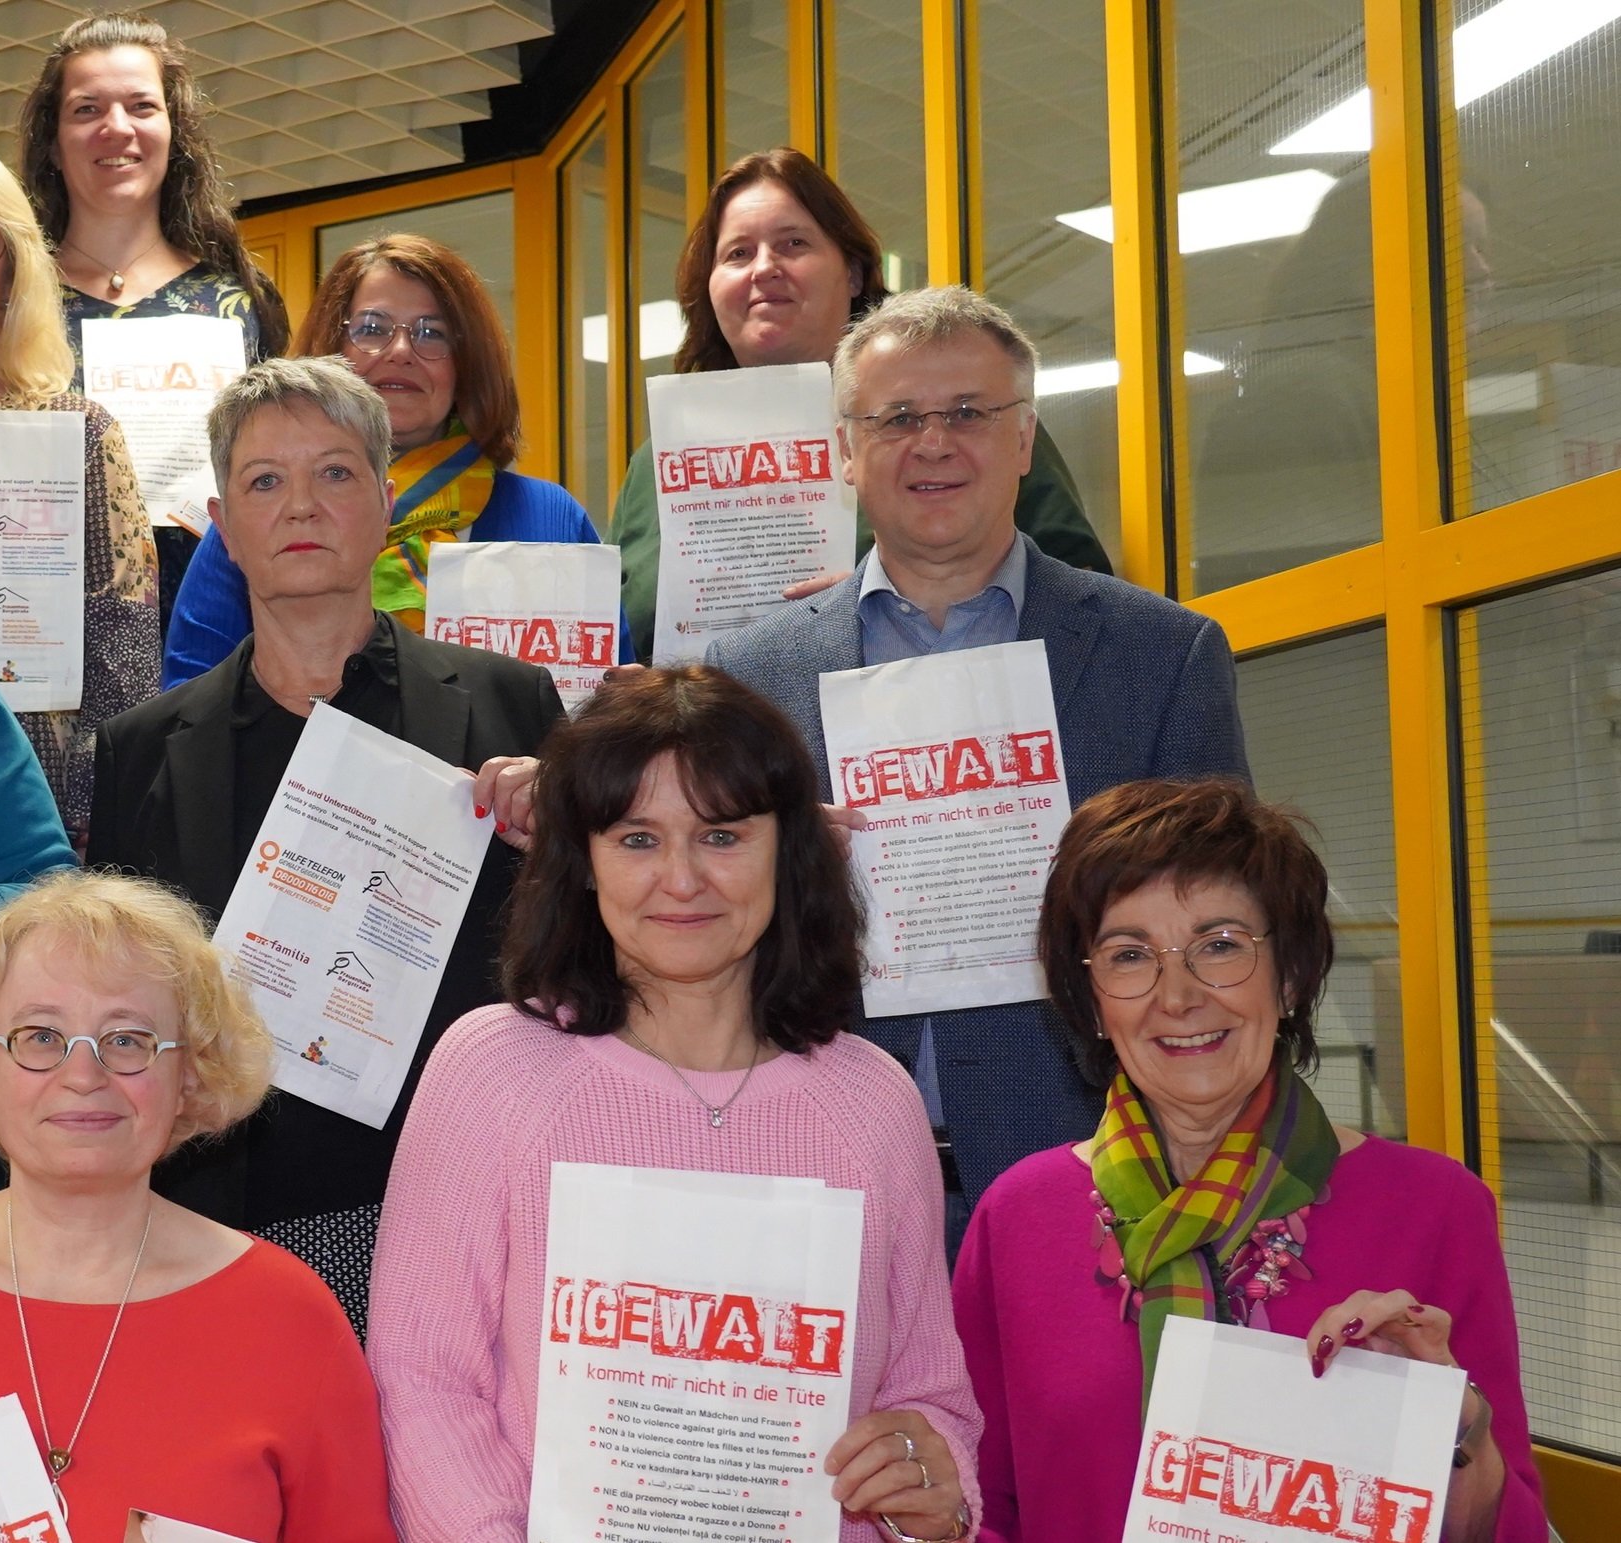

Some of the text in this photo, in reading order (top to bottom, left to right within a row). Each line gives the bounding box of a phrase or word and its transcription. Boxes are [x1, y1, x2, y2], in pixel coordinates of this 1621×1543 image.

[658, 439, 833, 493] GEWALT
[670, 490, 825, 514] kommt mir nicht in die Tüte
[554, 676, 571, 689] die
[839, 730, 1060, 808] GEWALT
[286, 778, 377, 825] Hilfe und Unterstützung
[860, 796, 1052, 832] ommt mir nicht in die Tüte
[270, 940, 311, 964] familia
[579, 1278, 845, 1377] GEWALT
[586, 1362, 645, 1386] kommt
[651, 1373, 678, 1390] mir
[683, 1376, 726, 1397] nicht
[732, 1380, 747, 1399] in
[753, 1383, 778, 1402] die
[785, 1386, 826, 1406] Tüte
[616, 1398, 639, 1408] NEIN
[652, 1403, 684, 1415] Gewalt
[698, 1408, 739, 1421] Mädchen
[740, 1416, 759, 1424] und
[760, 1416, 792, 1427] Frauen
[616, 1413, 790, 1442] NO to violence against girls and women
[1141, 1430, 1434, 1543] GEWALT
[1148, 1515, 1211, 1543] kommt
